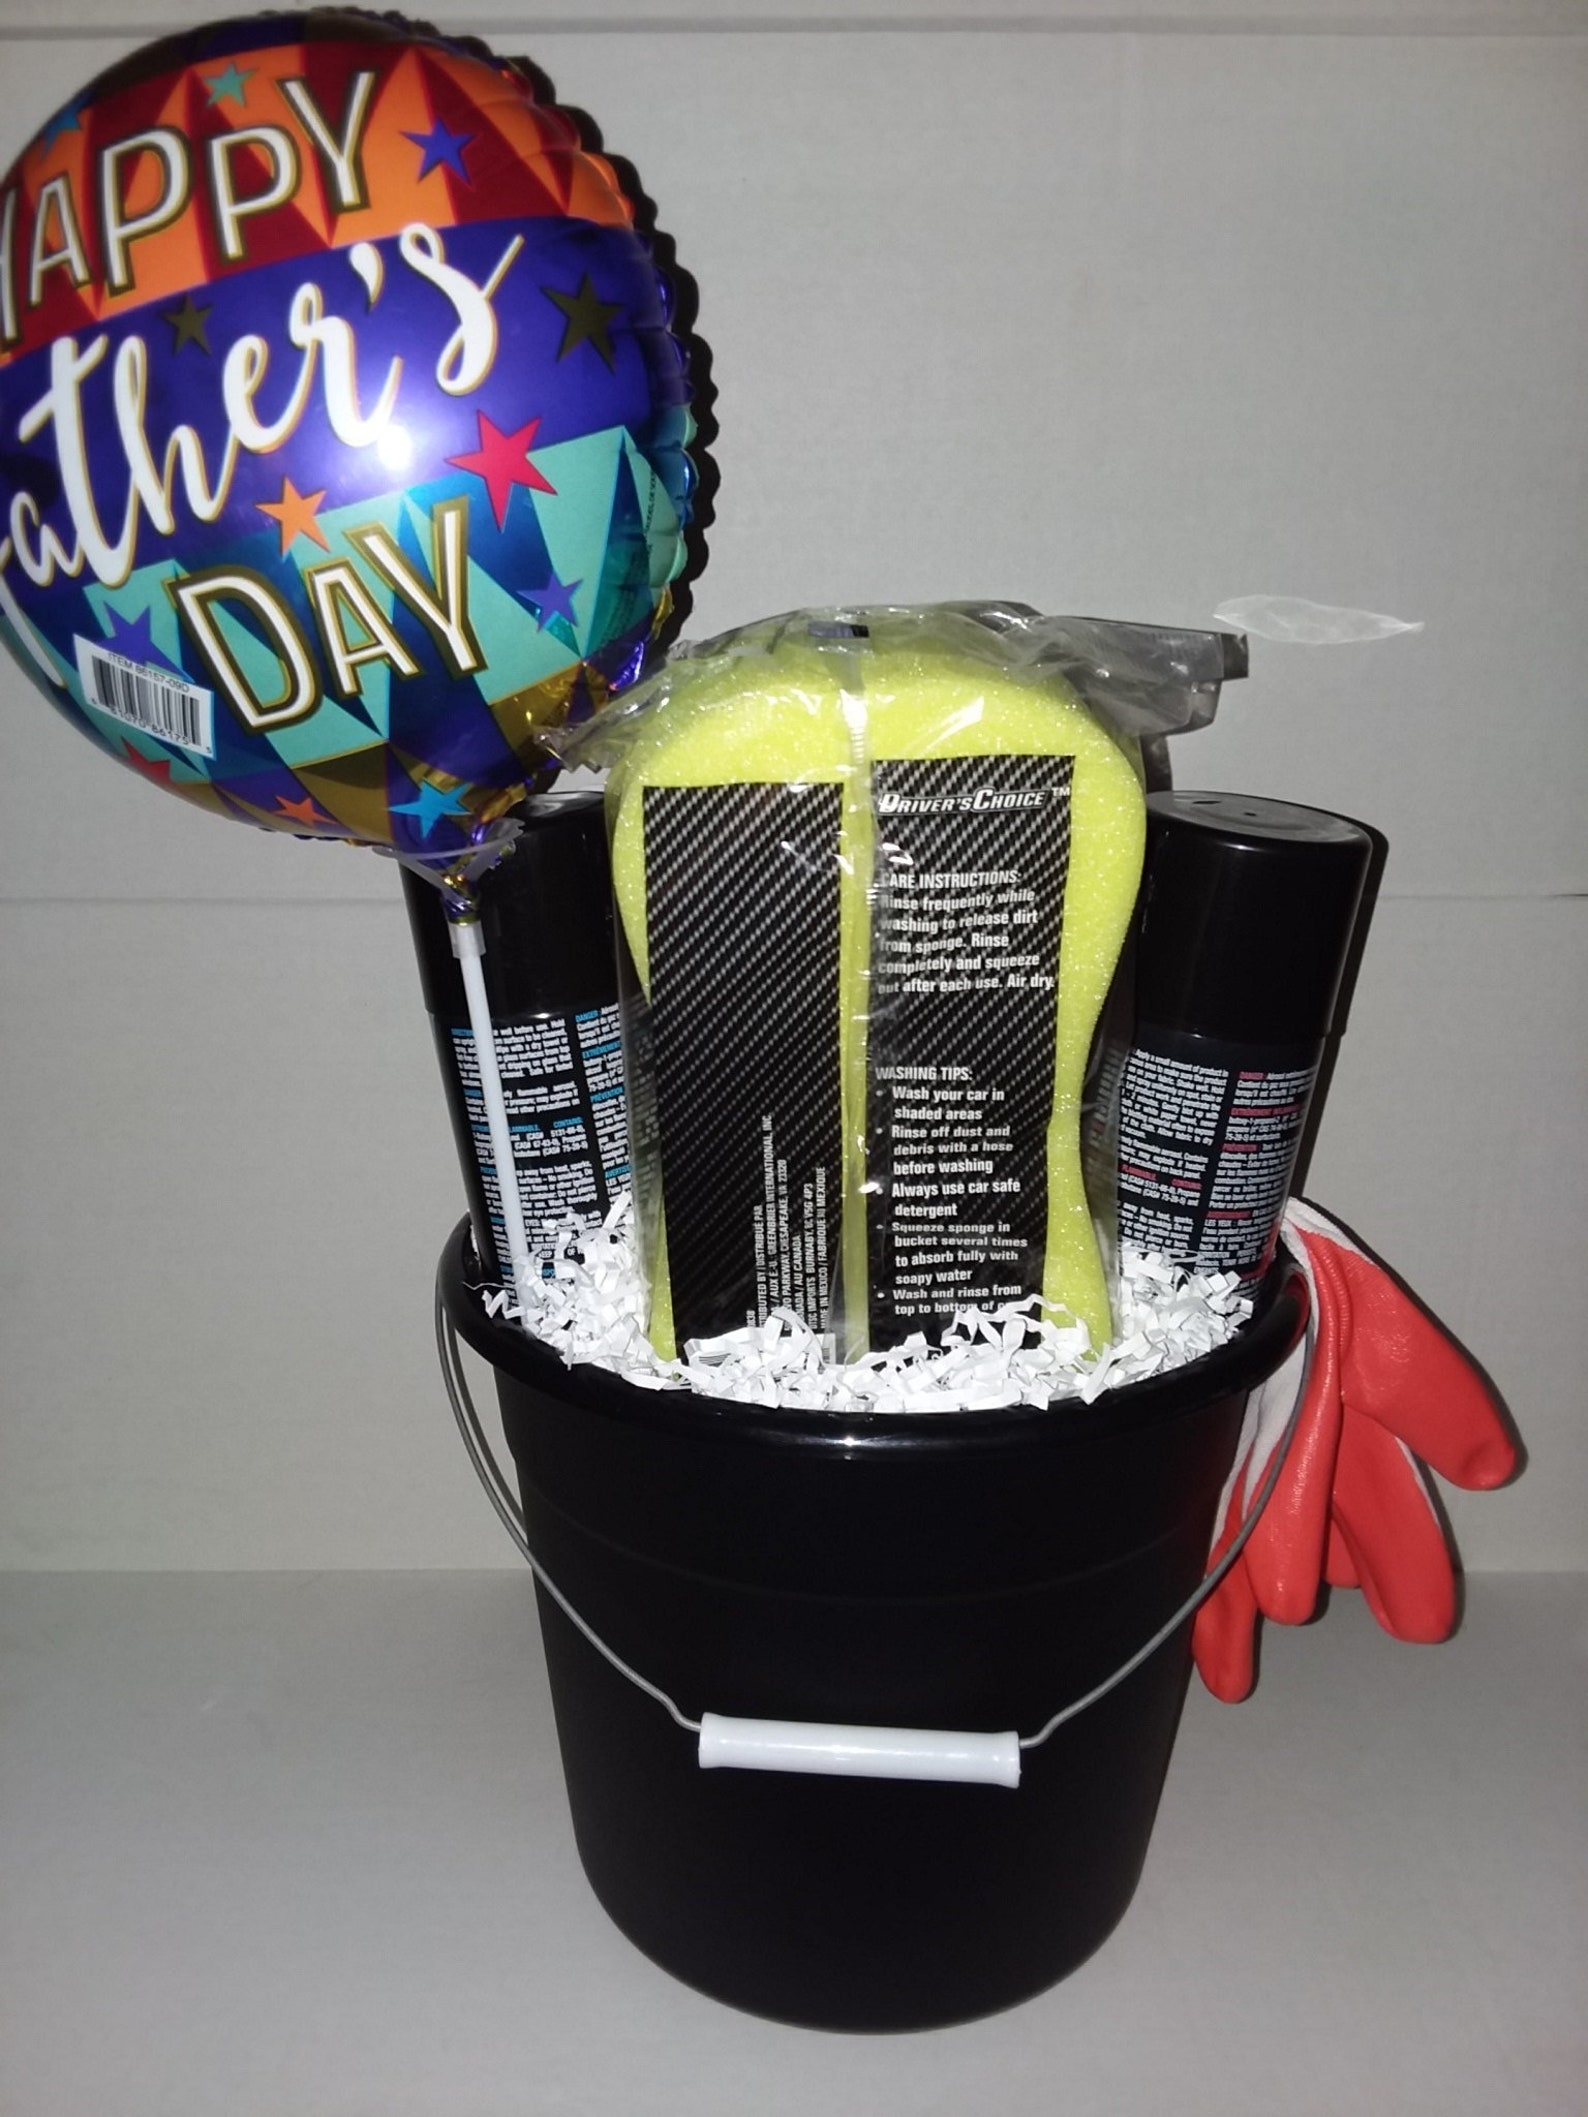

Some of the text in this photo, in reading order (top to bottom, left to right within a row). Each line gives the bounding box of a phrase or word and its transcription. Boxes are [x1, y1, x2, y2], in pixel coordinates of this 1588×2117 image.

[162, 495, 488, 735] DAY
[107, 651, 133, 669] ITEM
[919, 870, 1021, 888] INSTRUCTIONS:
[923, 892, 993, 912] frequently
[998, 889, 1035, 903] while
[943, 917, 955, 929] to
[959, 911, 1008, 927] release
[1013, 910, 1038, 924] dirt
[915, 934, 966, 954] sponge.
[971, 933, 1009, 947] Rinse
[956, 955, 981, 970] and
[985, 954, 1040, 971] squeeze
[903, 977, 936, 992] after
[940, 976, 971, 991] each
[975, 977, 1002, 989] use.
[1007, 974, 1026, 988] Air
[1030, 974, 1055, 990] dry.
[876, 1067, 972, 1080] WASHING TIPS:
[892, 1086, 1005, 1103] Wash your car in
[894, 1107, 982, 1120] shaded areas
[892, 1125, 1010, 1138] Rinse off dust and
[894, 1142, 1013, 1155] debris with a hose
[893, 1160, 994, 1175] before washing
[892, 1179, 1021, 1198] Always use car safe
[895, 1203, 957, 1219] detergent
[892, 1222, 1010, 1235] Squeeze sponge in
[894, 1236, 1027, 1247] bucket several times
[896, 1250, 1018, 1267] to absorb fully with
[896, 1268, 972, 1286] soapy water
[893, 1285, 1022, 1300] Wash and rinse from
[895, 1304, 915, 1316] top
[919, 1303, 931, 1314] to
[982, 1301, 995, 1311] of
